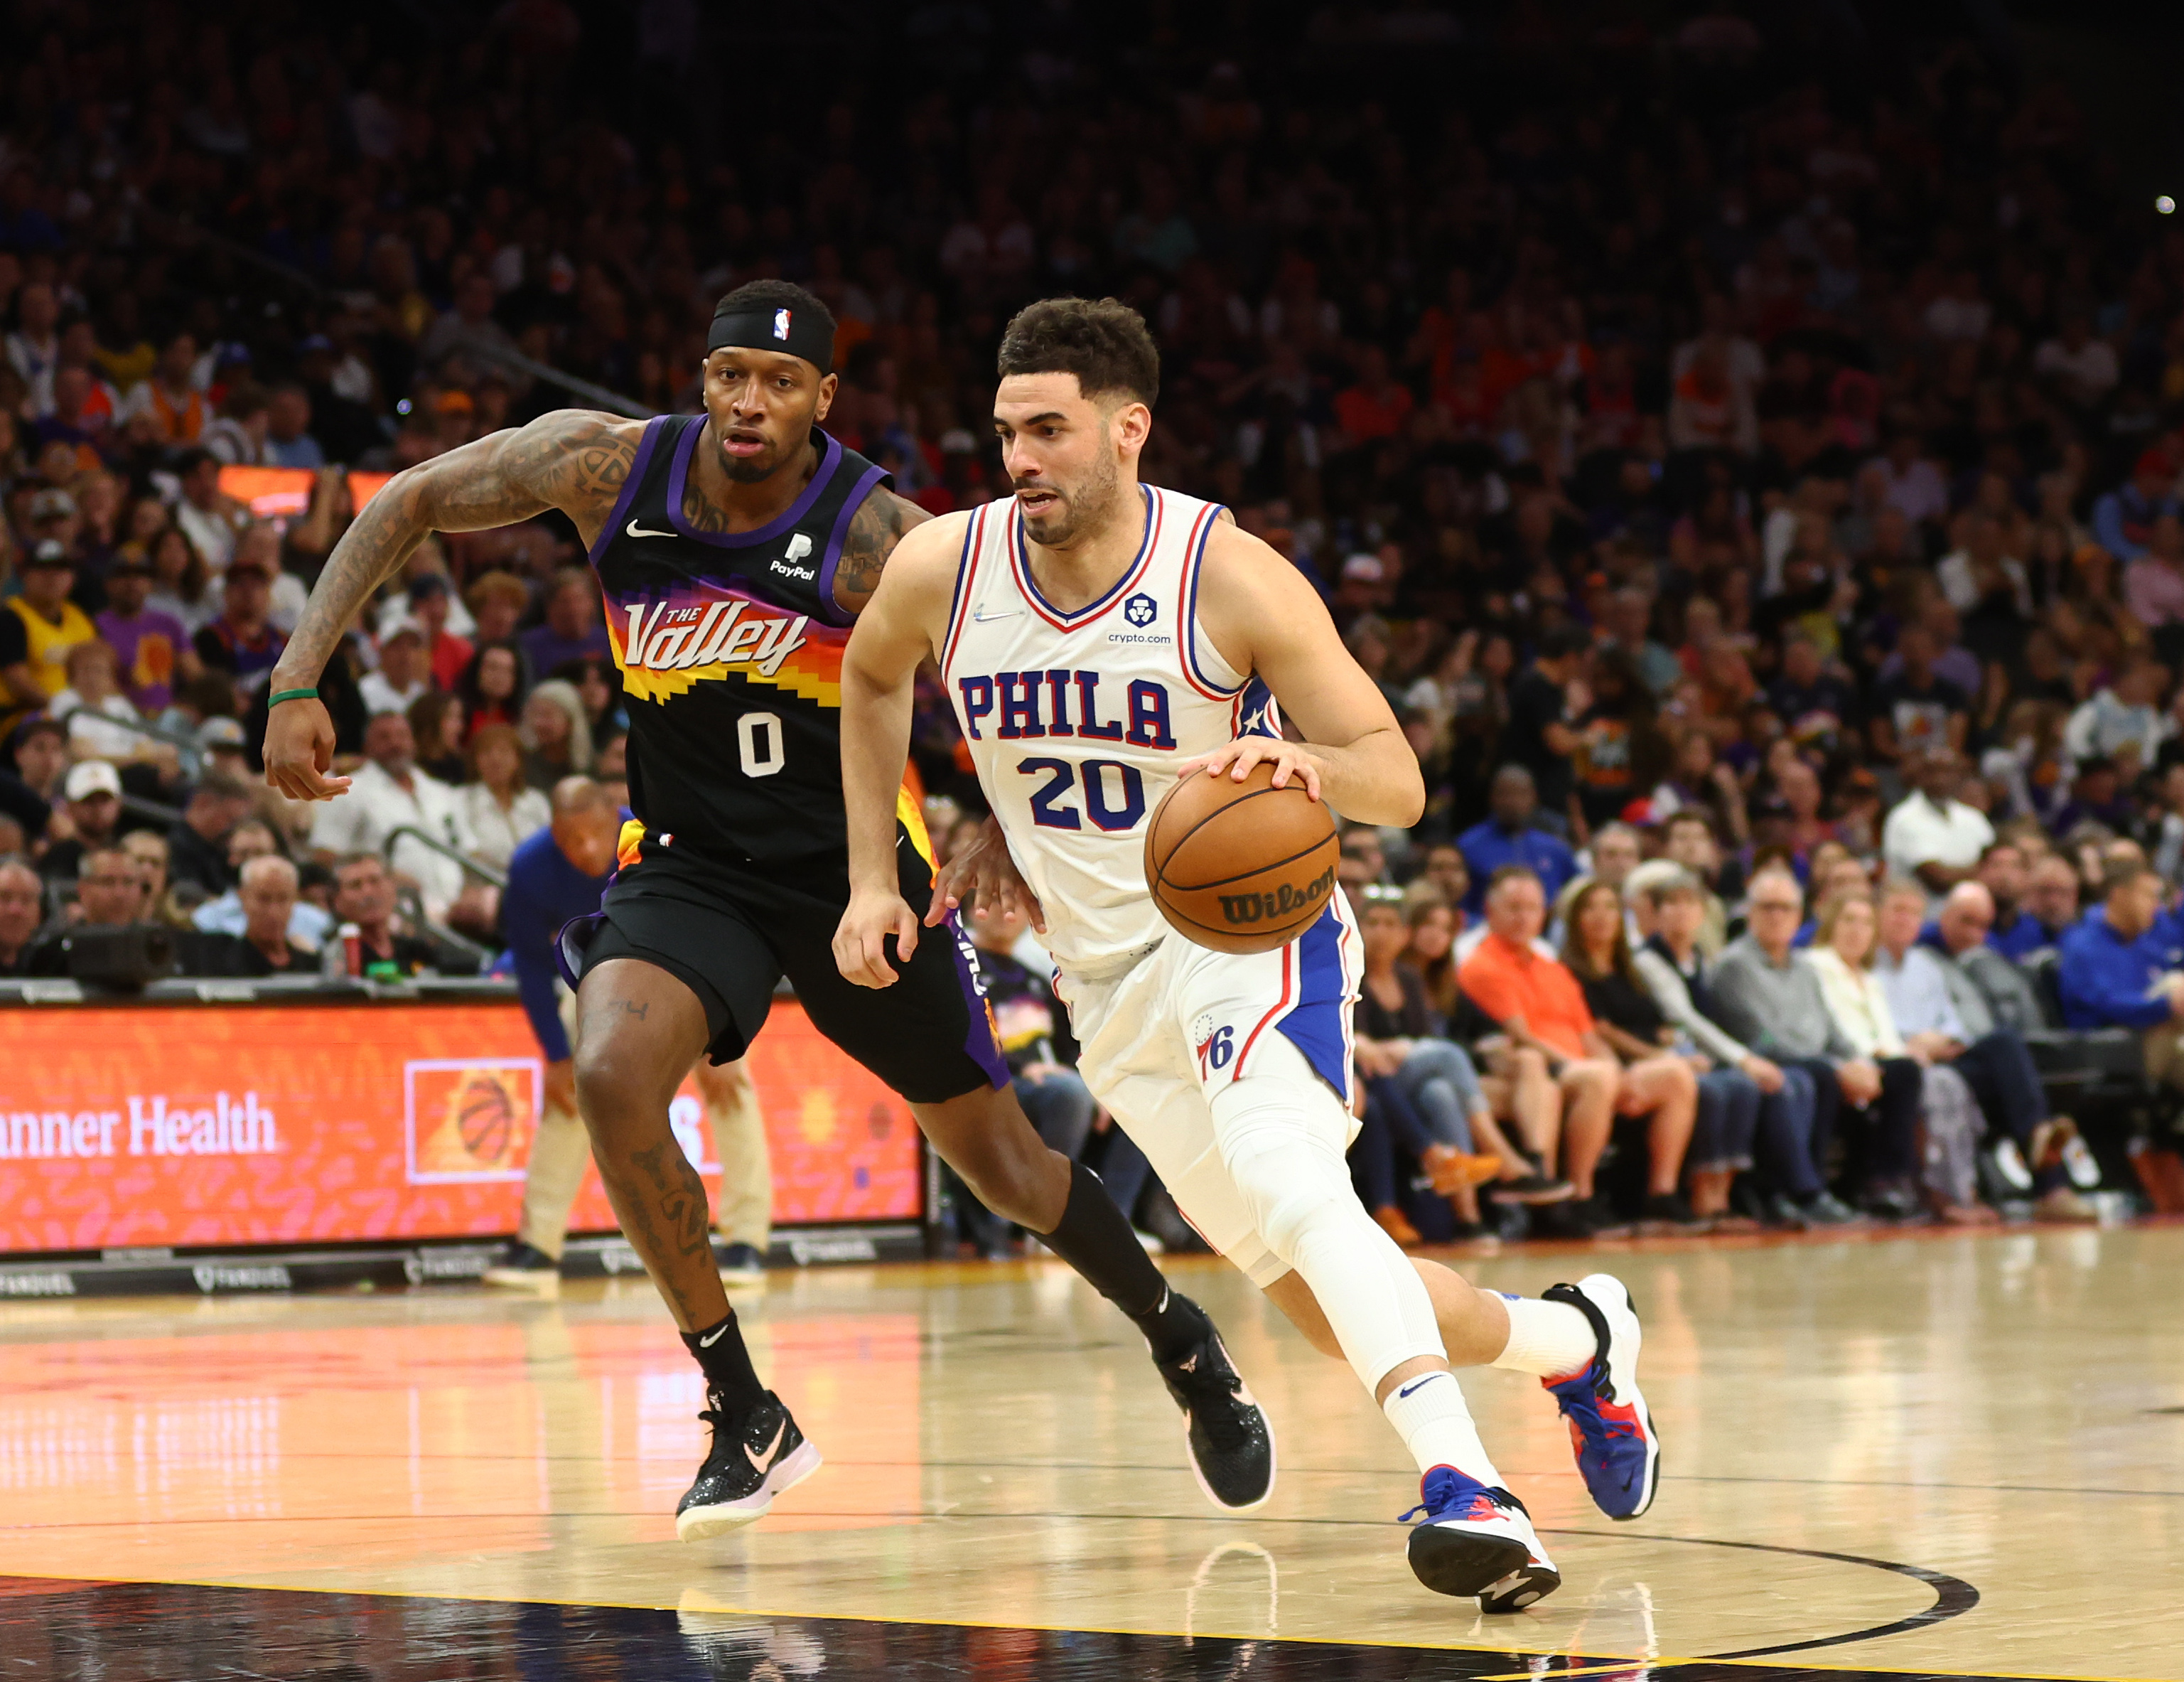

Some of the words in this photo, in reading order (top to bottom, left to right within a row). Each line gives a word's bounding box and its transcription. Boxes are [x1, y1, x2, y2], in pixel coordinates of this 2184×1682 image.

[770, 560, 815, 581] PayPal
[624, 601, 809, 677] Valley
[667, 608, 702, 623] THE
[1108, 633, 1171, 644] crypto.com
[959, 669, 1177, 751] PHILA
[737, 712, 785, 778] 0
[1016, 757, 1146, 832] 20
[1218, 864, 1335, 925] Wilson
[127, 1090, 277, 1156] Health
